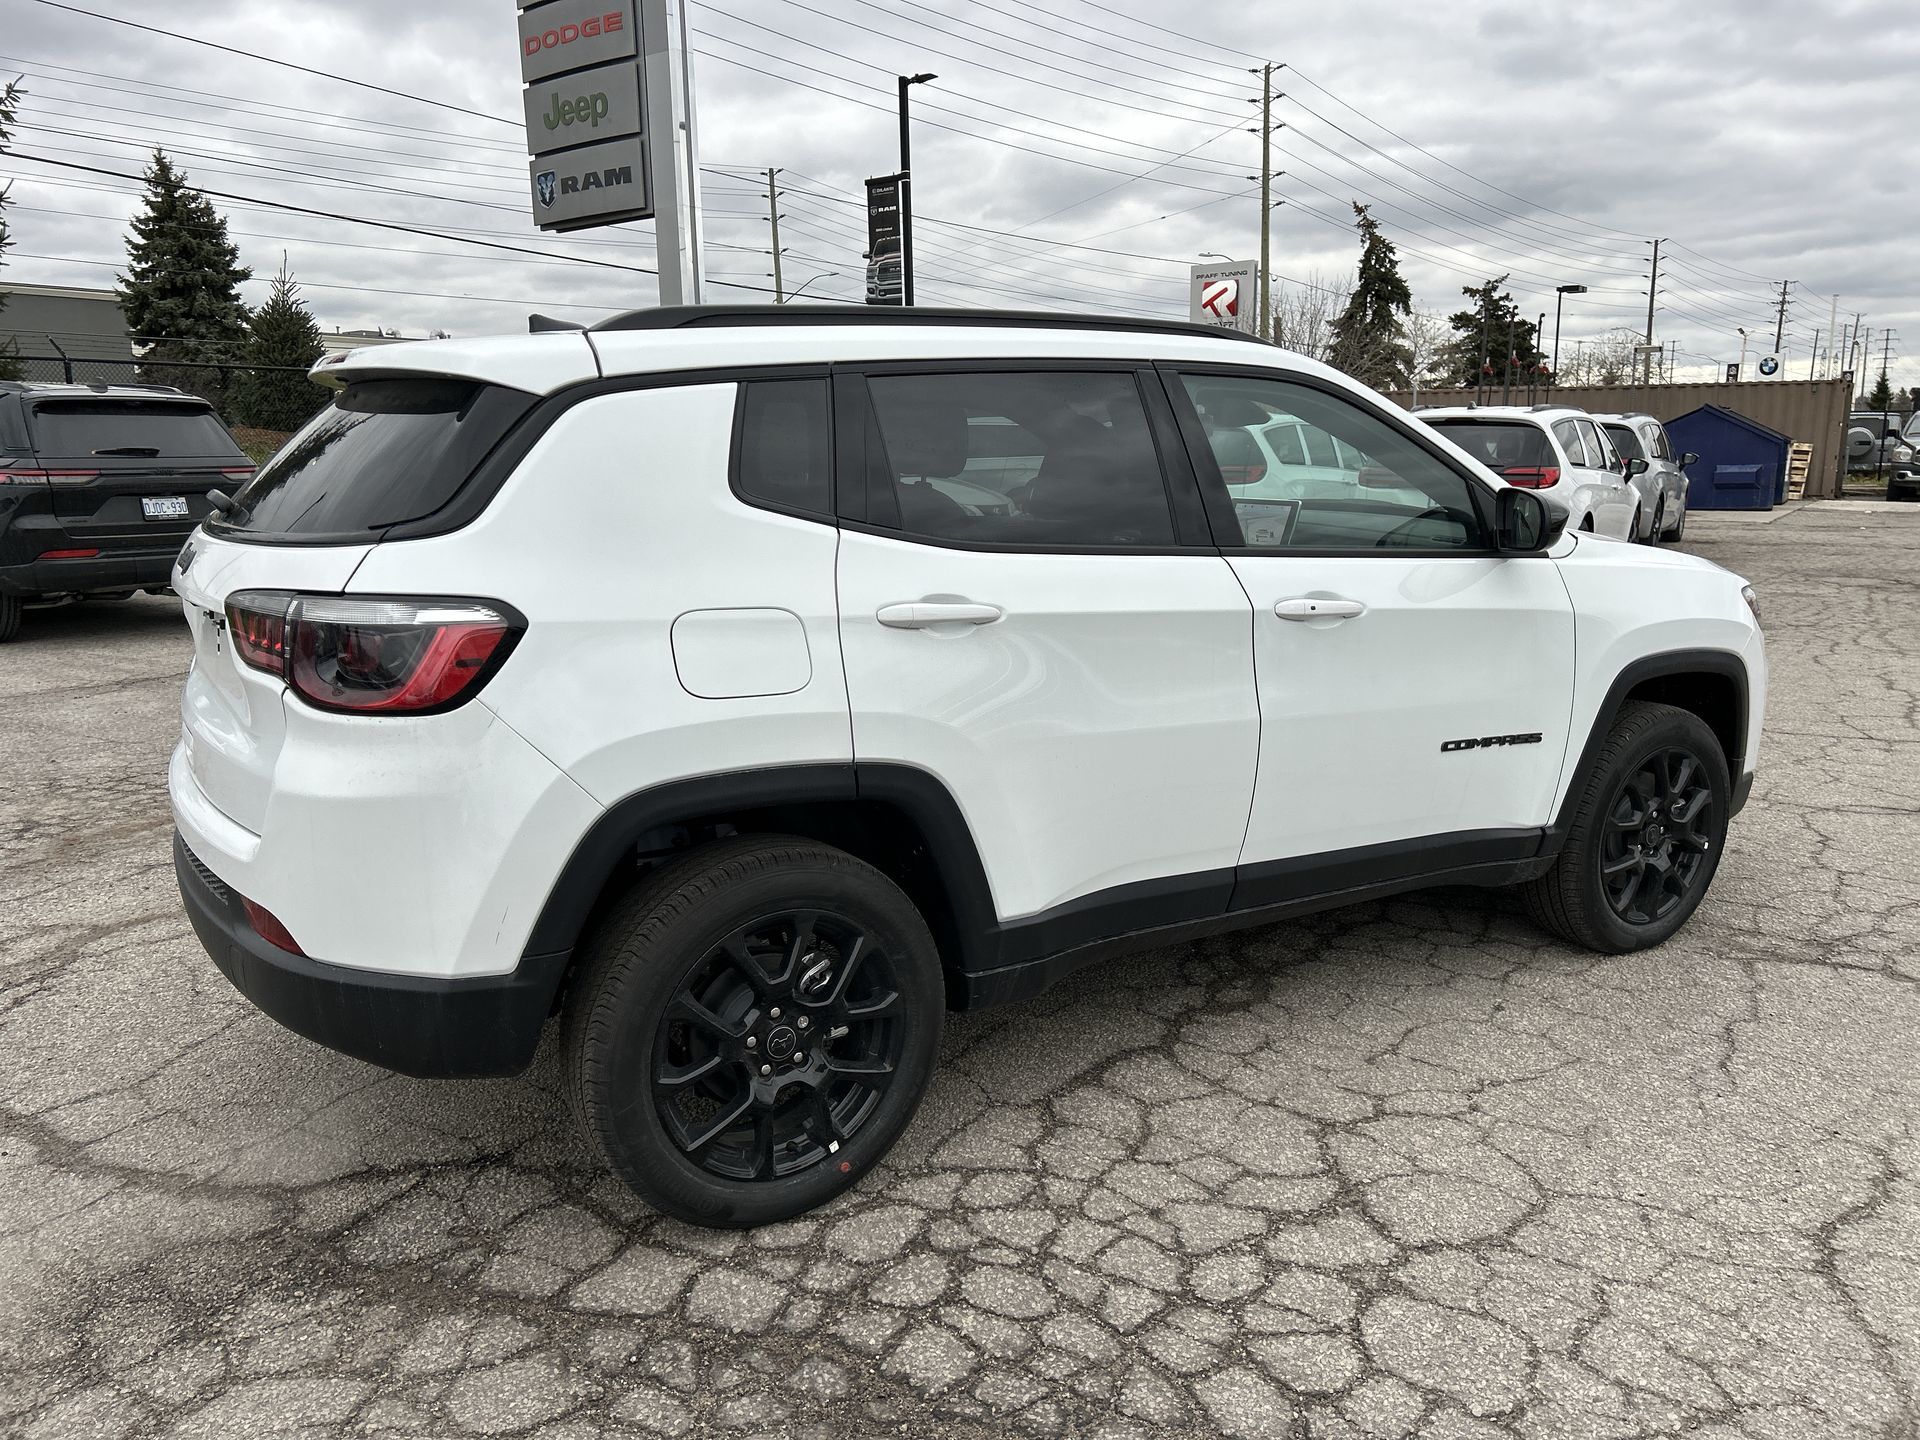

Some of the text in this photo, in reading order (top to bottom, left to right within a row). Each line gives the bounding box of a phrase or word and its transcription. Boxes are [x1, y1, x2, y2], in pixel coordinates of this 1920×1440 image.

[524, 11, 624, 57] DODGE
[543, 91, 609, 131] Jeep
[560, 166, 633, 195] RAM
[878, 205, 897, 213] RAM
[171, 501, 187, 513] 930
[1441, 732, 1543, 752] COMPASS
